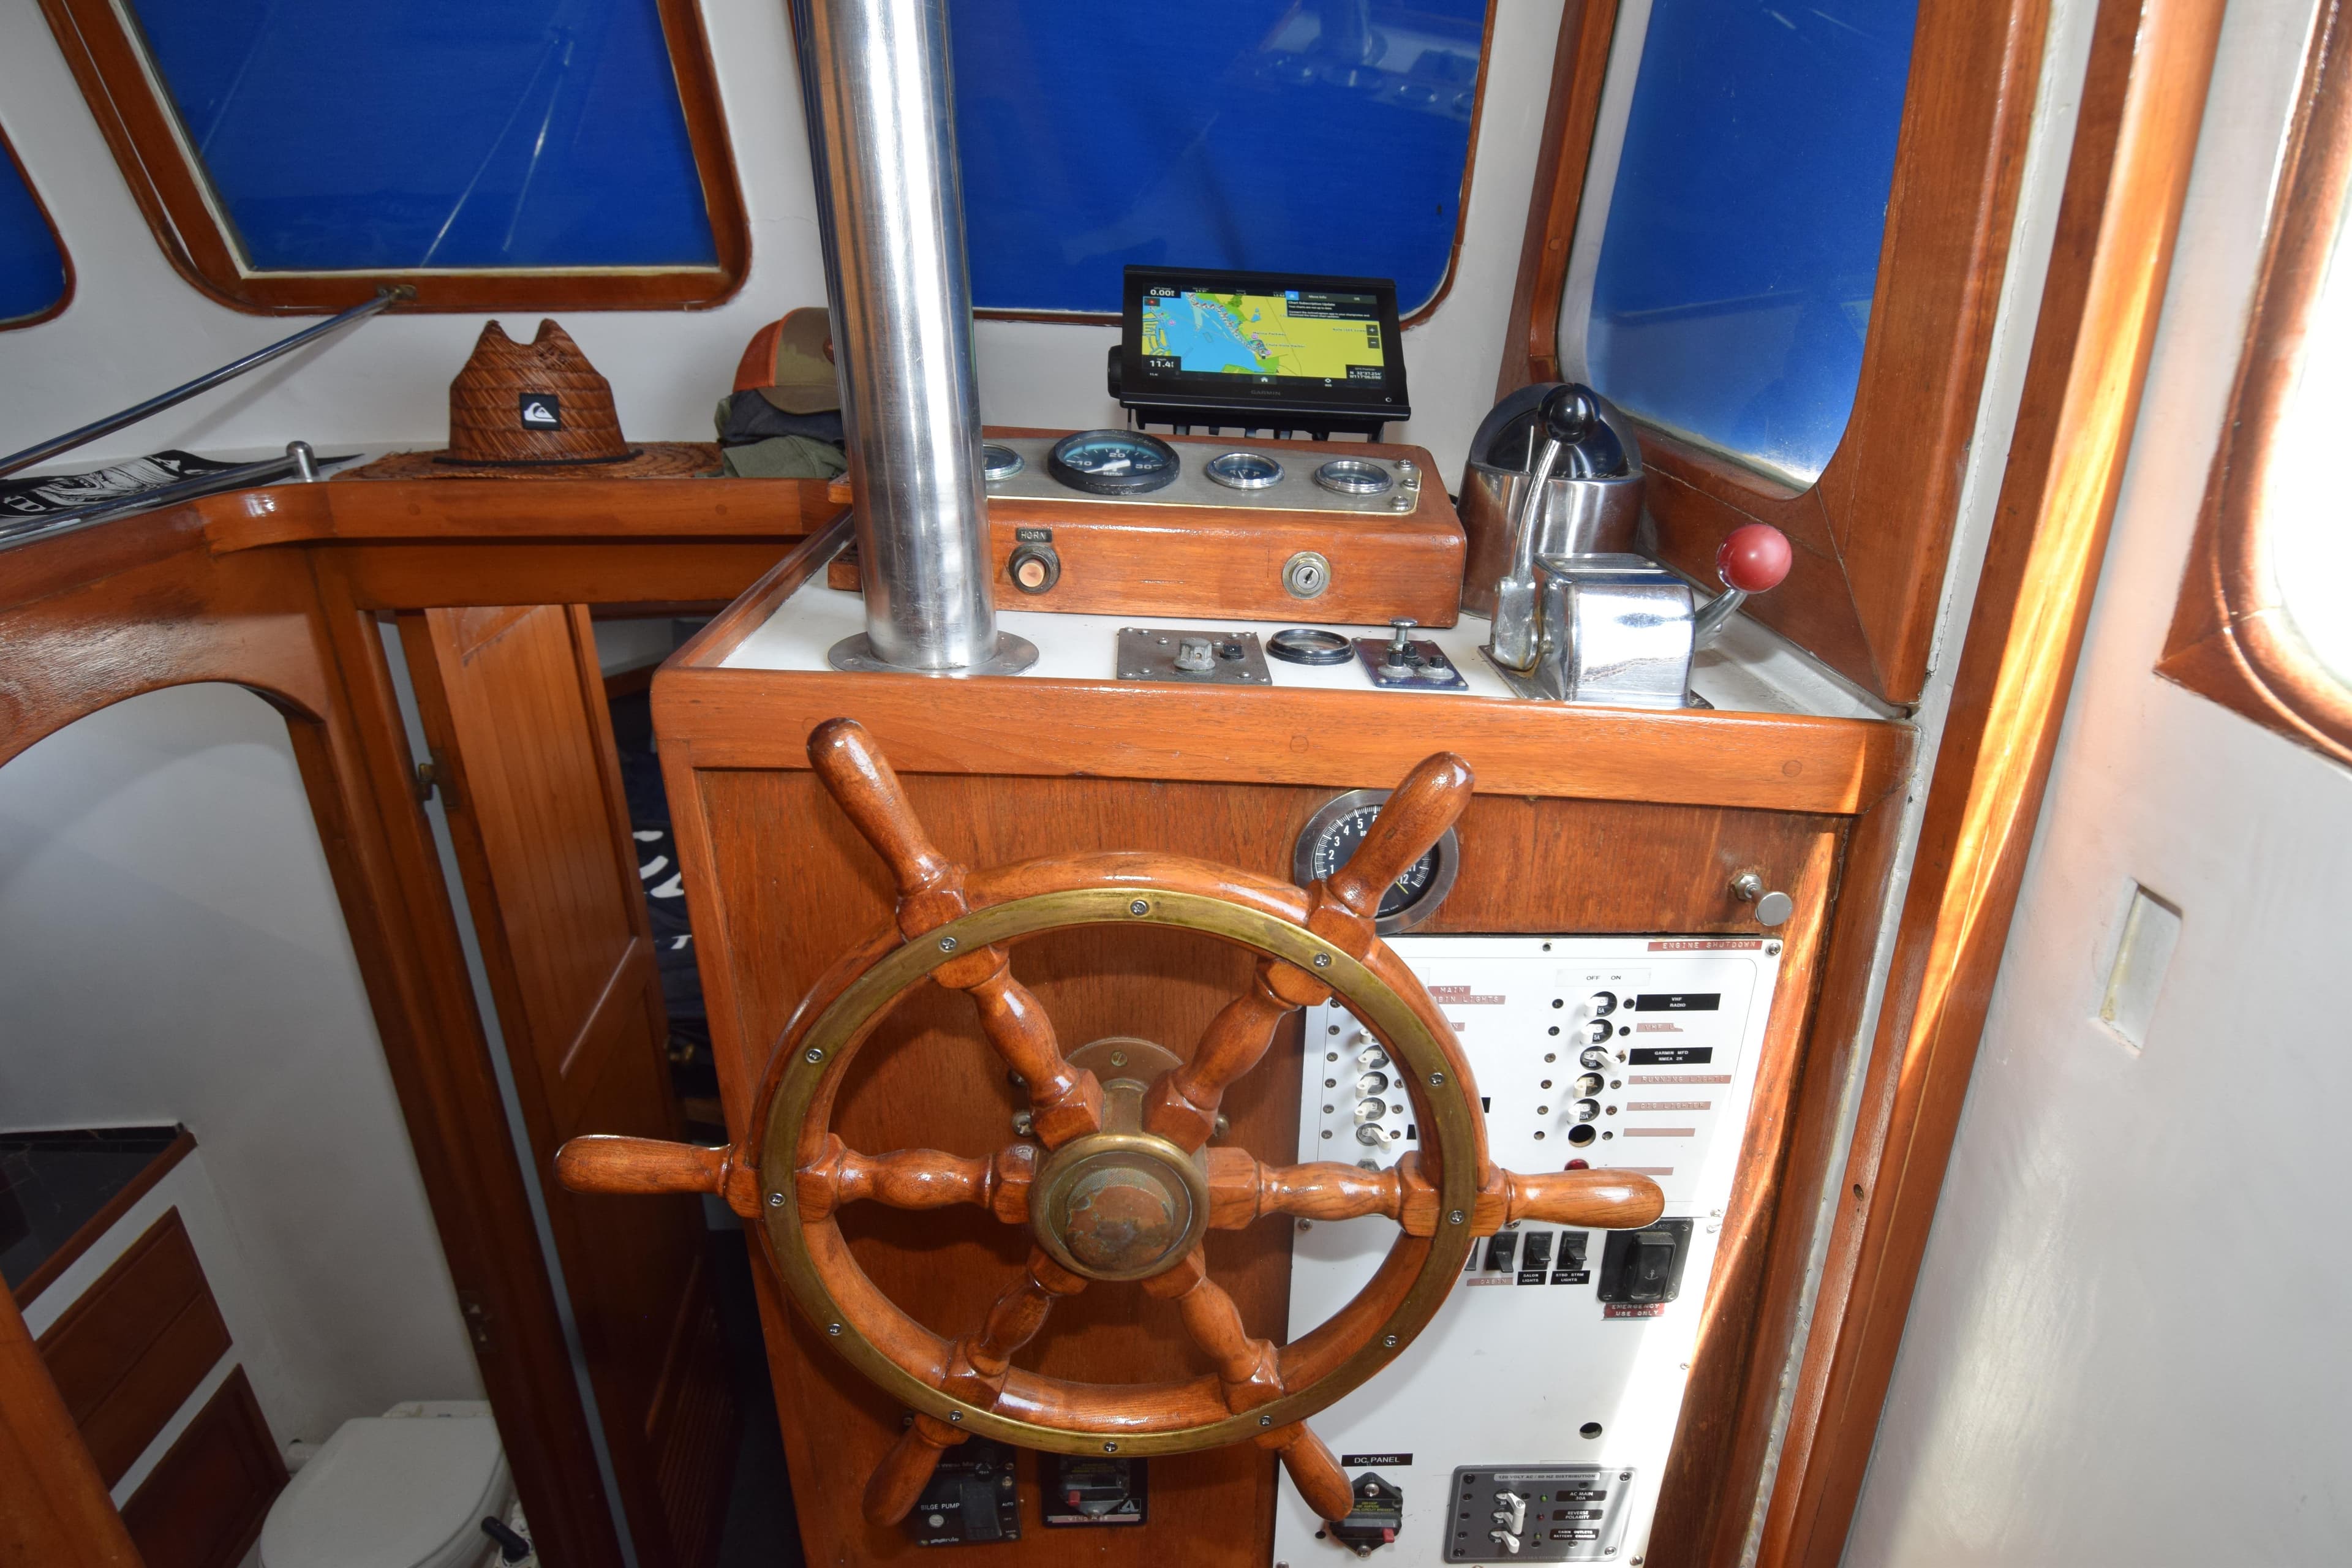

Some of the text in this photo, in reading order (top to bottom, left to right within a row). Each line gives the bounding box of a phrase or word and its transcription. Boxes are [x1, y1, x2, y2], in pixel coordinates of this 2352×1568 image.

[1021, 531, 1046, 540] HORN
[1357, 819, 1363, 829] 5
[1343, 826, 1349, 835] 4
[1334, 836, 1340, 846] 3
[1329, 850, 1335, 860] 2
[1330, 865, 1334, 874] 1
[1400, 874, 1409, 884] 12
